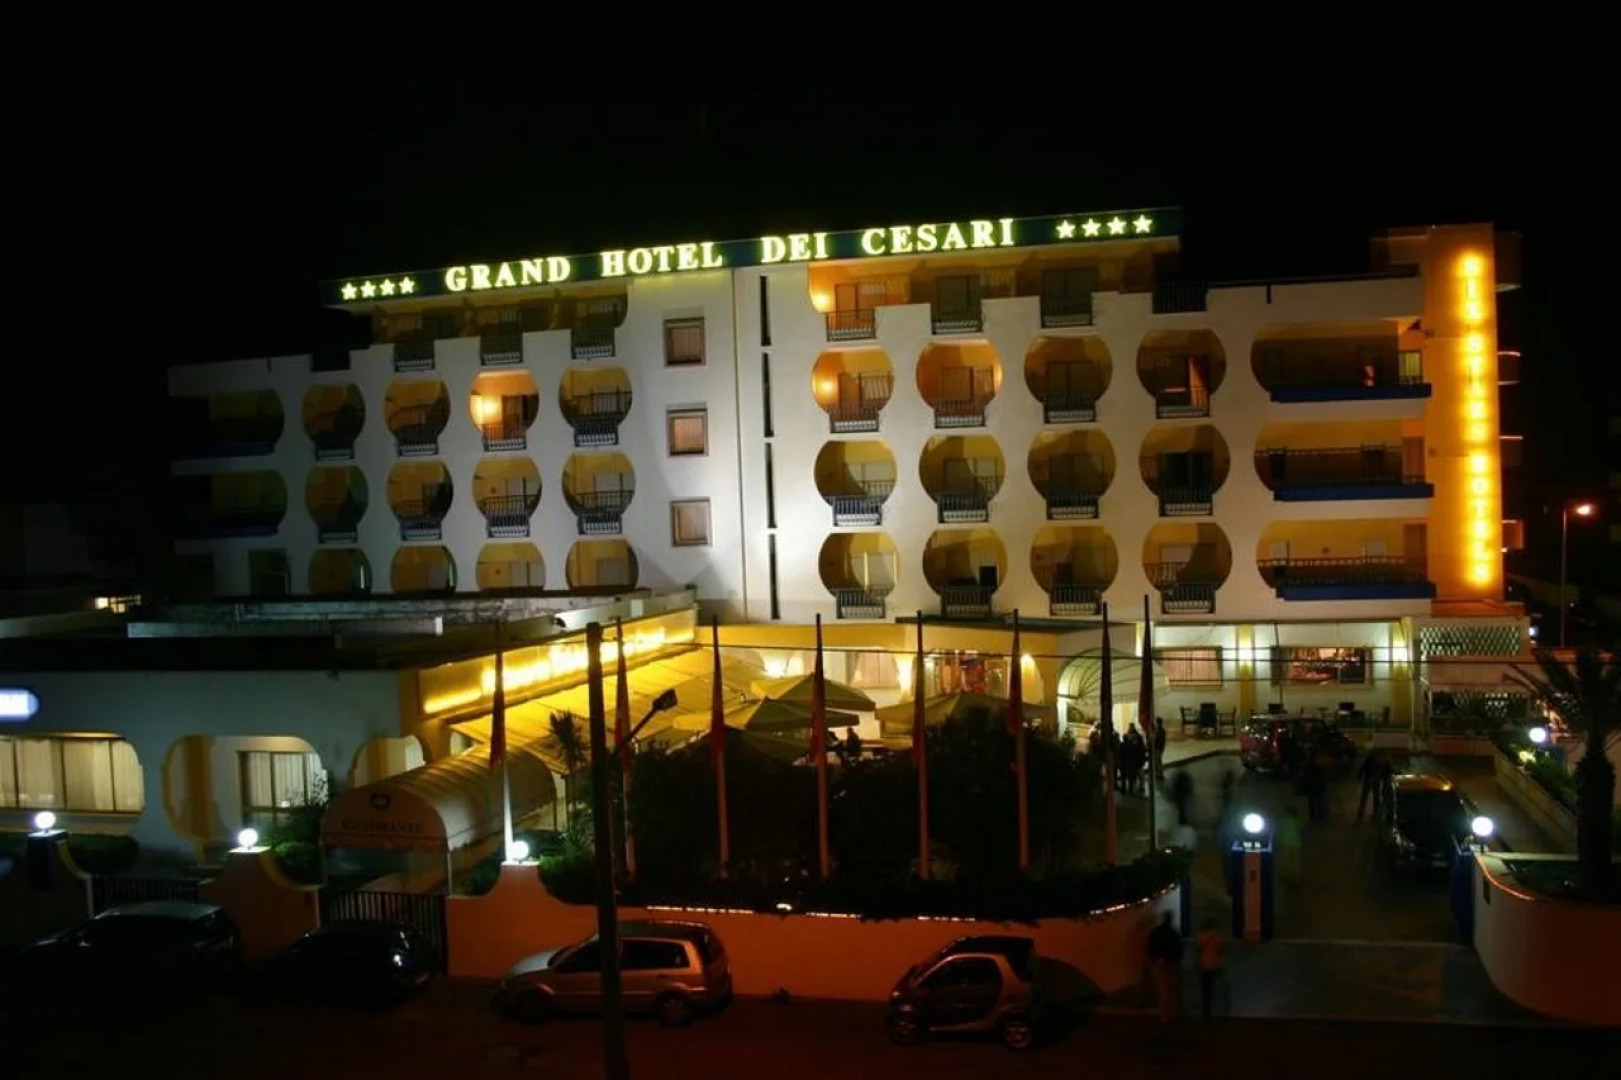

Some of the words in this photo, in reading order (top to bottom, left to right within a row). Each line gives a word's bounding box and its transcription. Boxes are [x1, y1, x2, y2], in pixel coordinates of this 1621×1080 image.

[446, 257, 570, 291] GRAND
[601, 242, 722, 276] HOTEL
[761, 233, 827, 263] DEI
[862, 219, 1013, 254] CESARI
